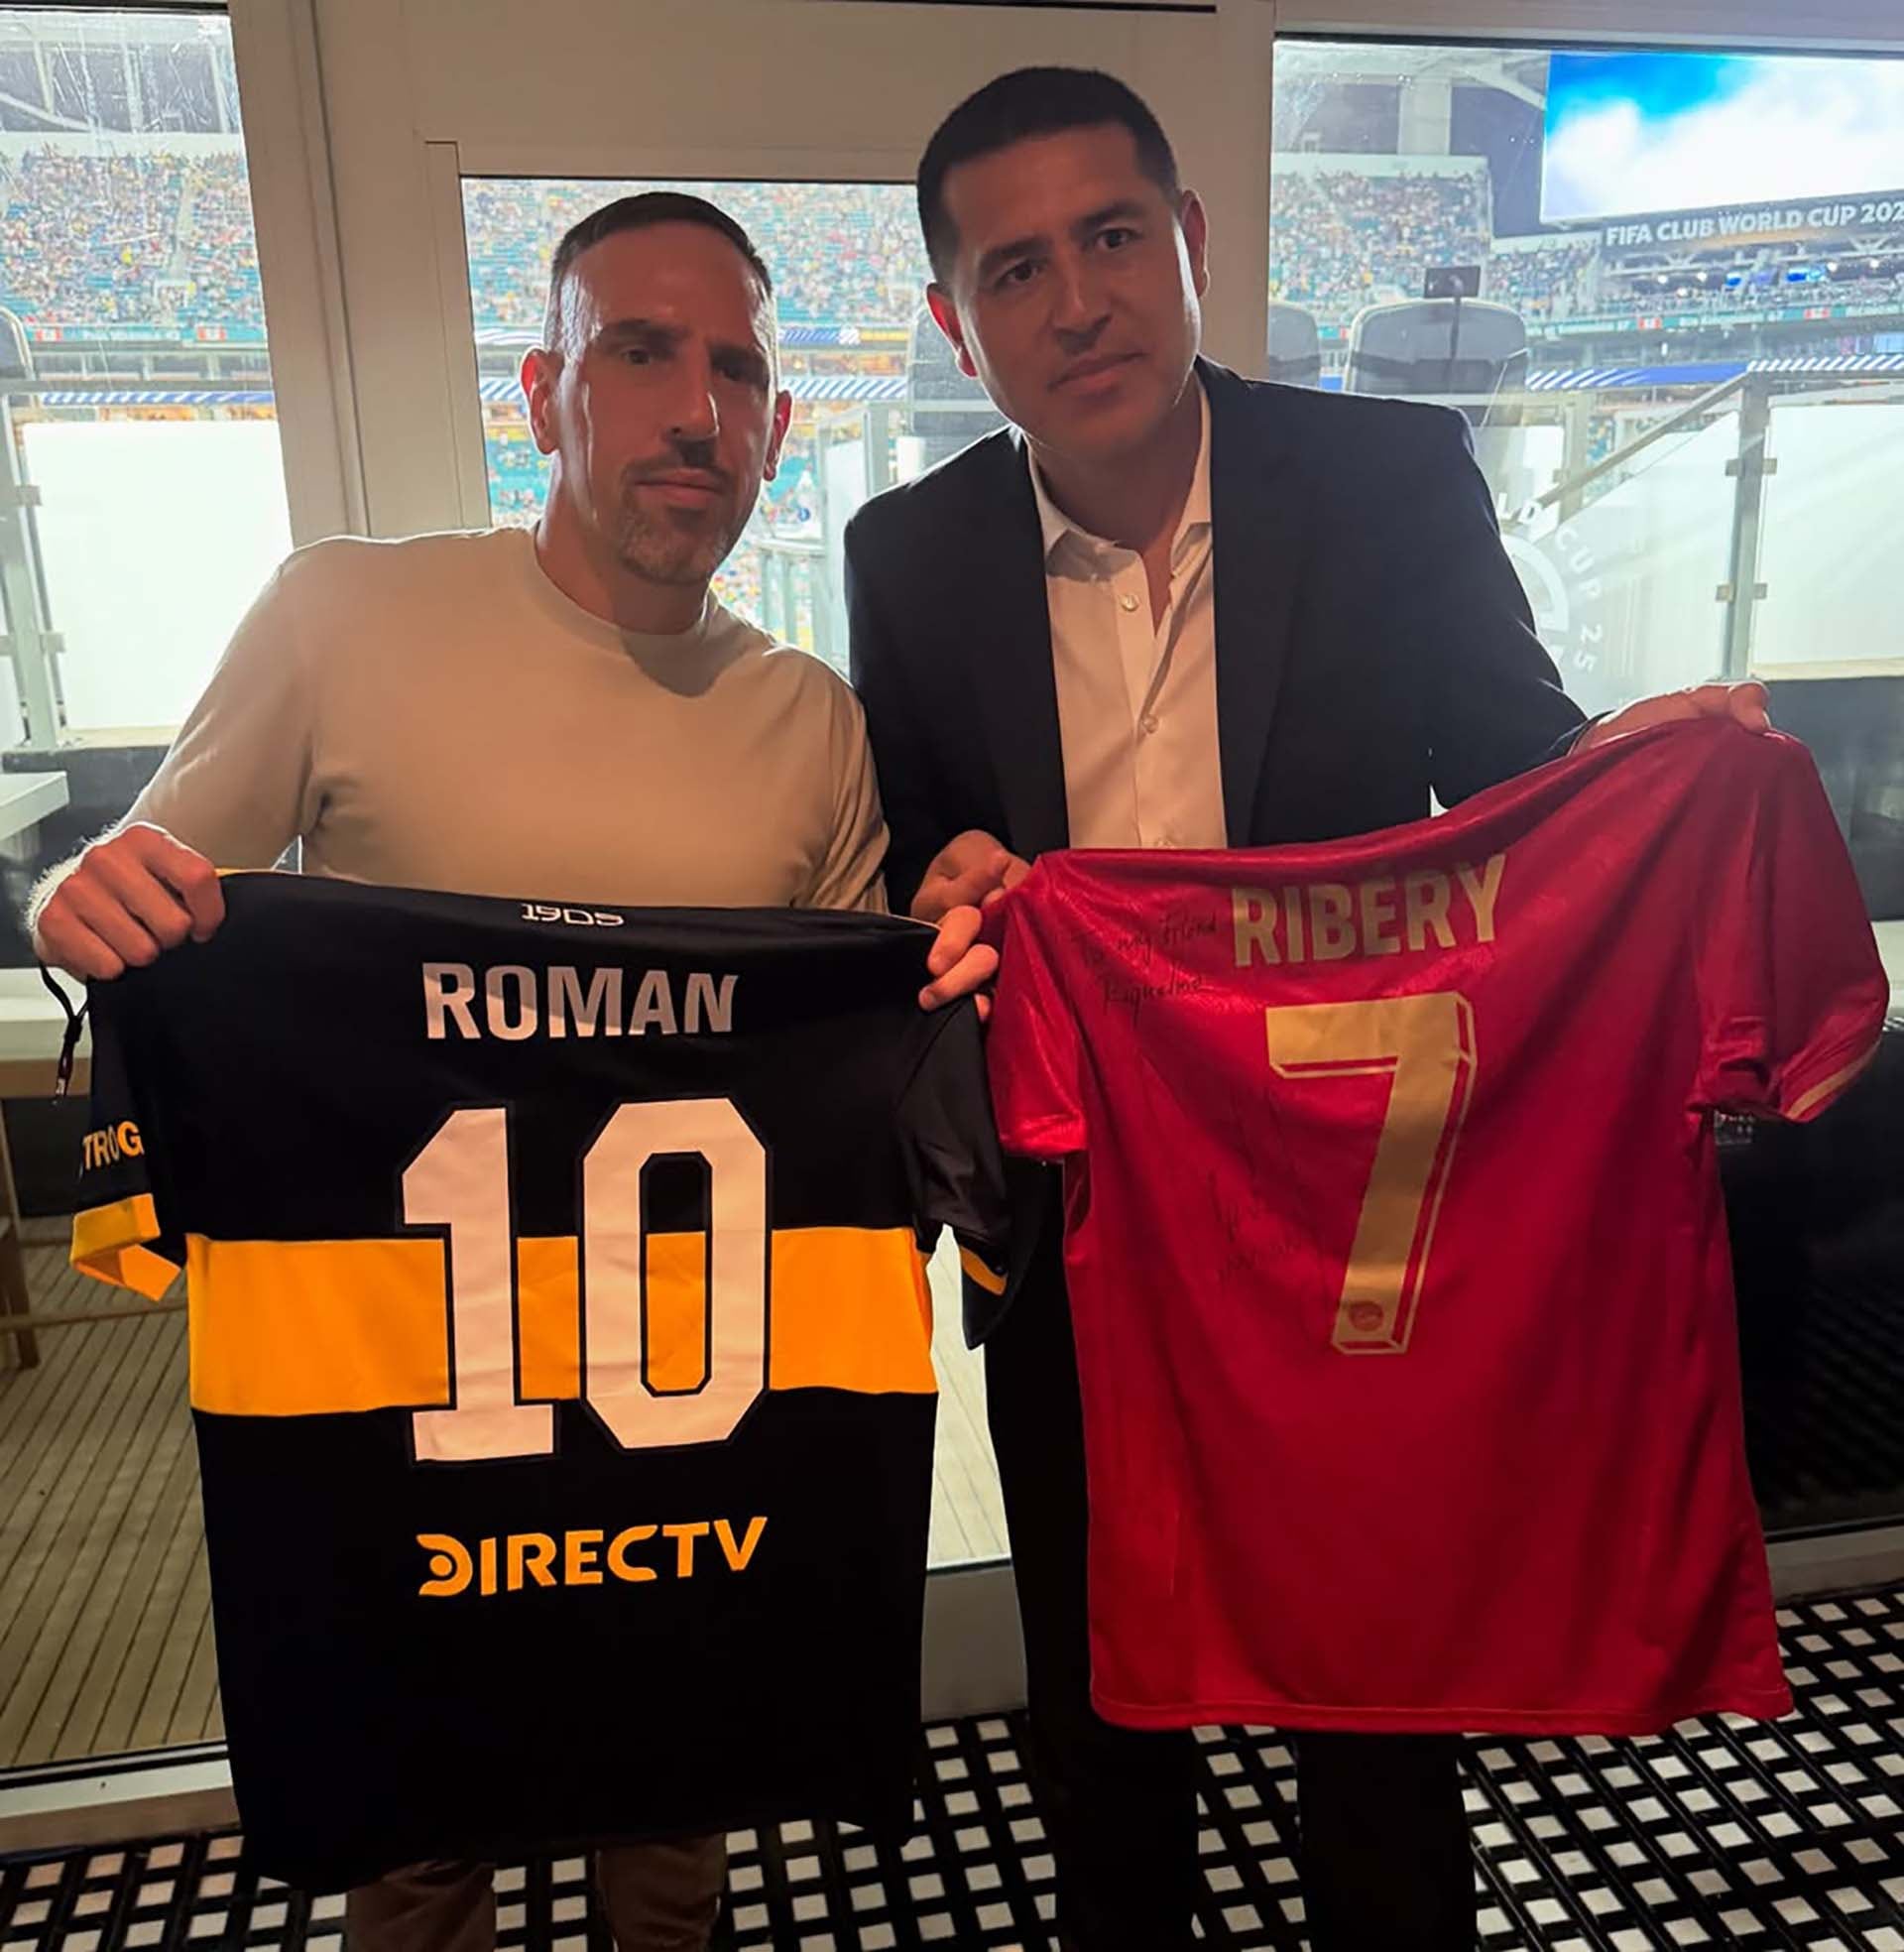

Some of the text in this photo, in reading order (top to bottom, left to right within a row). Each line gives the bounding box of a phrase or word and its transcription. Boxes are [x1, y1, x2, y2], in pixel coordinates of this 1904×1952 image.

[1606, 224, 1653, 247] FIFA
[1657, 217, 1714, 241] CLUB
[1719, 209, 1802, 235] WORLD
[1807, 204, 1856, 227] CUP
[1574, 624, 1604, 672] 25
[521, 903, 625, 926] 1905
[422, 961, 739, 1040] ROMAN
[1265, 991, 1477, 1356] 7
[402, 1097, 767, 1462] 10
[416, 1516, 769, 1597] DIRECTV
